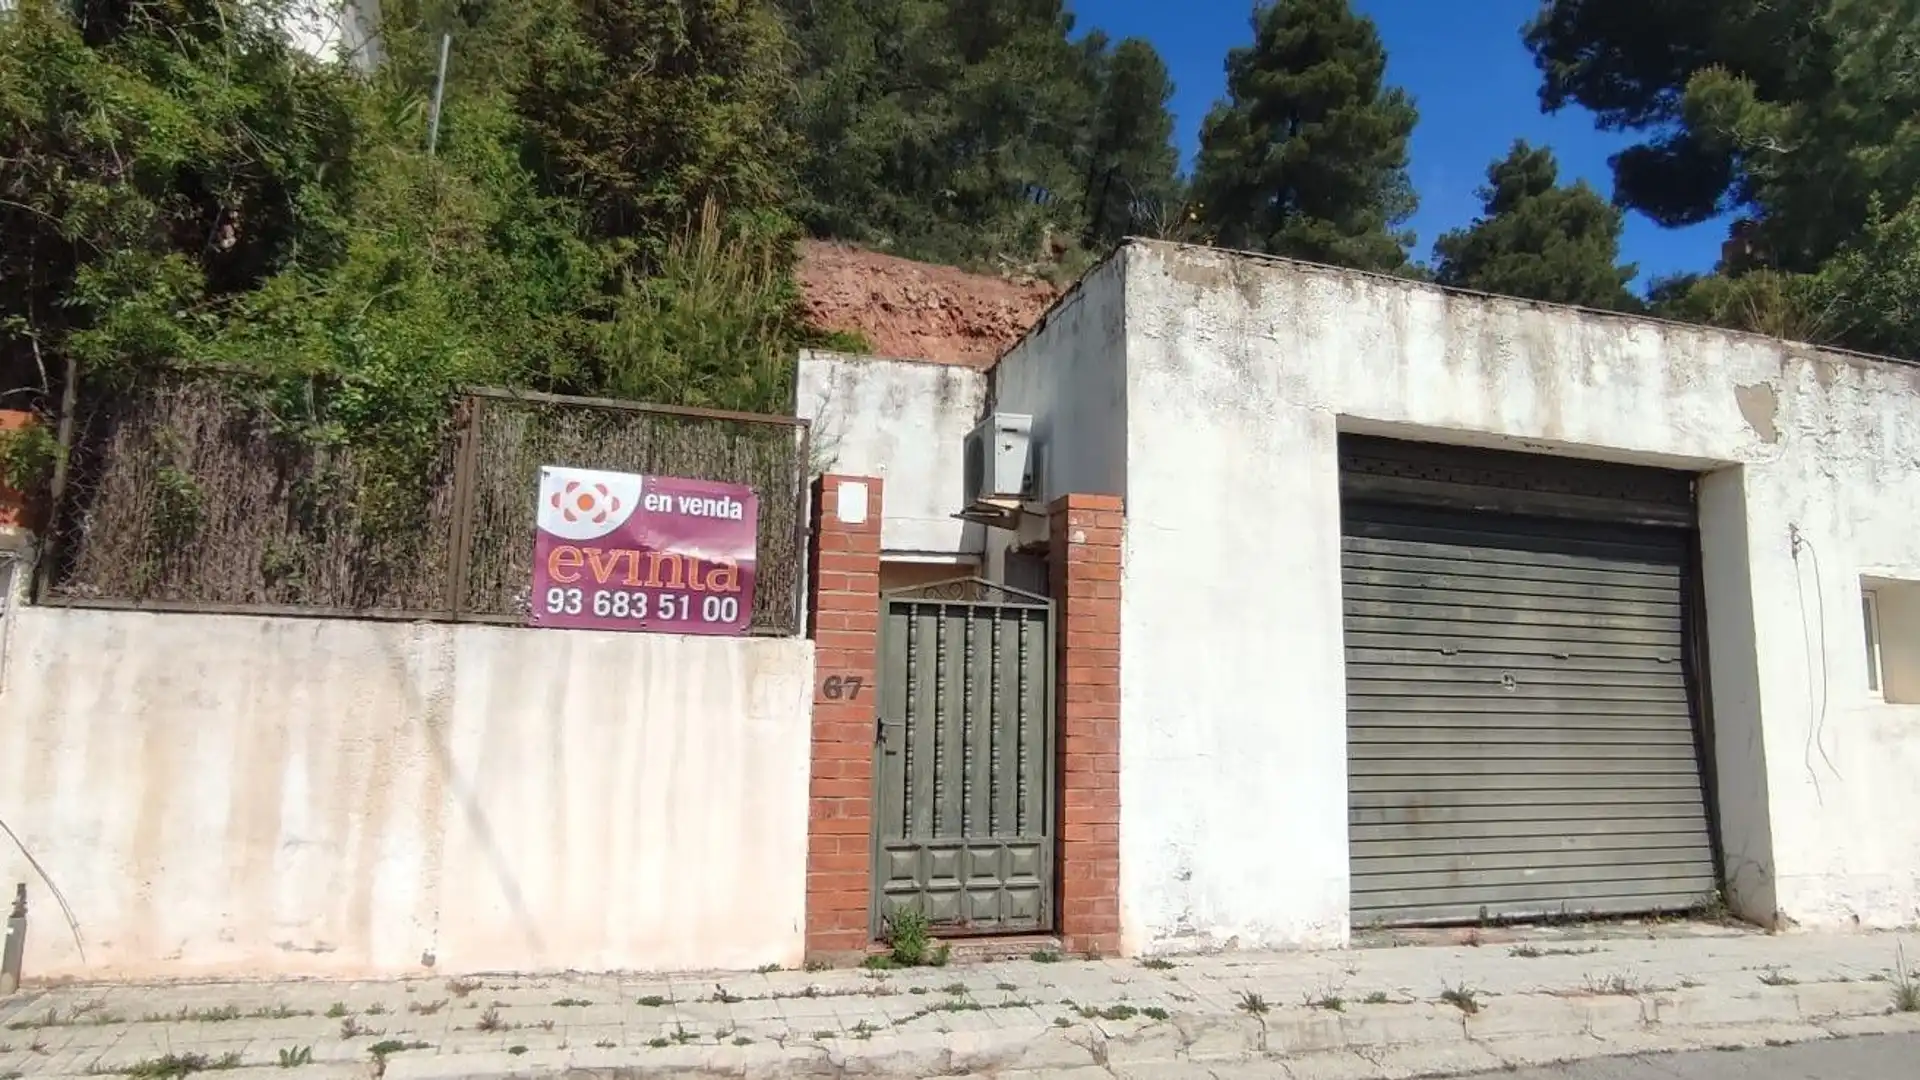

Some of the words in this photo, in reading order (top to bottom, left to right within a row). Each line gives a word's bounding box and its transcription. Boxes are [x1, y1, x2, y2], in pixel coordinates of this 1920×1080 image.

[644, 493, 673, 513] en
[678, 496, 743, 521] venda
[548, 545, 741, 592] evinta
[547, 588, 583, 614] 93
[593, 590, 648, 618] 683
[658, 594, 690, 621] 51
[702, 596, 738, 622] 00
[823, 675, 863, 700] 67
